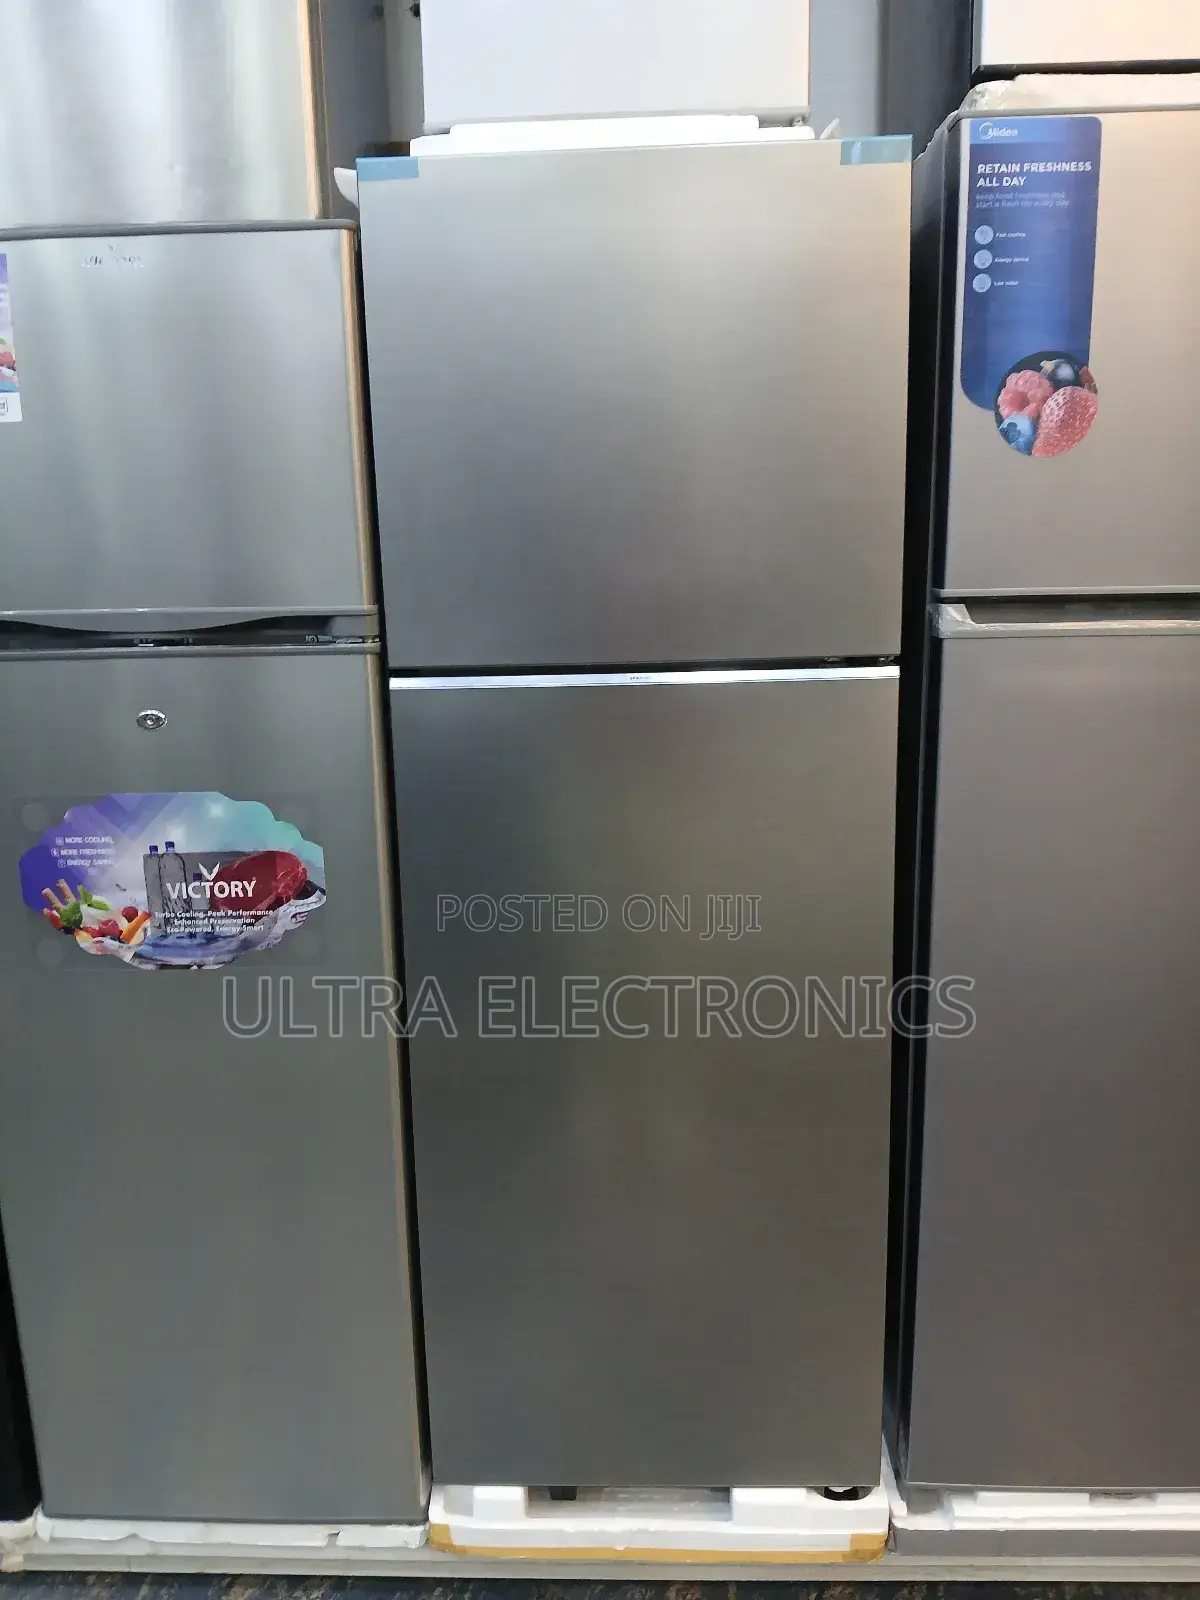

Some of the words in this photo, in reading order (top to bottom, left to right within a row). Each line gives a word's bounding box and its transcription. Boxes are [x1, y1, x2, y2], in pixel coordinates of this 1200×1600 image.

[977, 163, 1020, 174] RETAIN
[1023, 161, 1092, 172] FRESHNESS
[976, 177, 1000, 187] ALL
[1002, 176, 1026, 187] DAY
[165, 880, 257, 899] VICTORY
[208, 908, 226, 917] Peak
[227, 907, 275, 917] Performance
